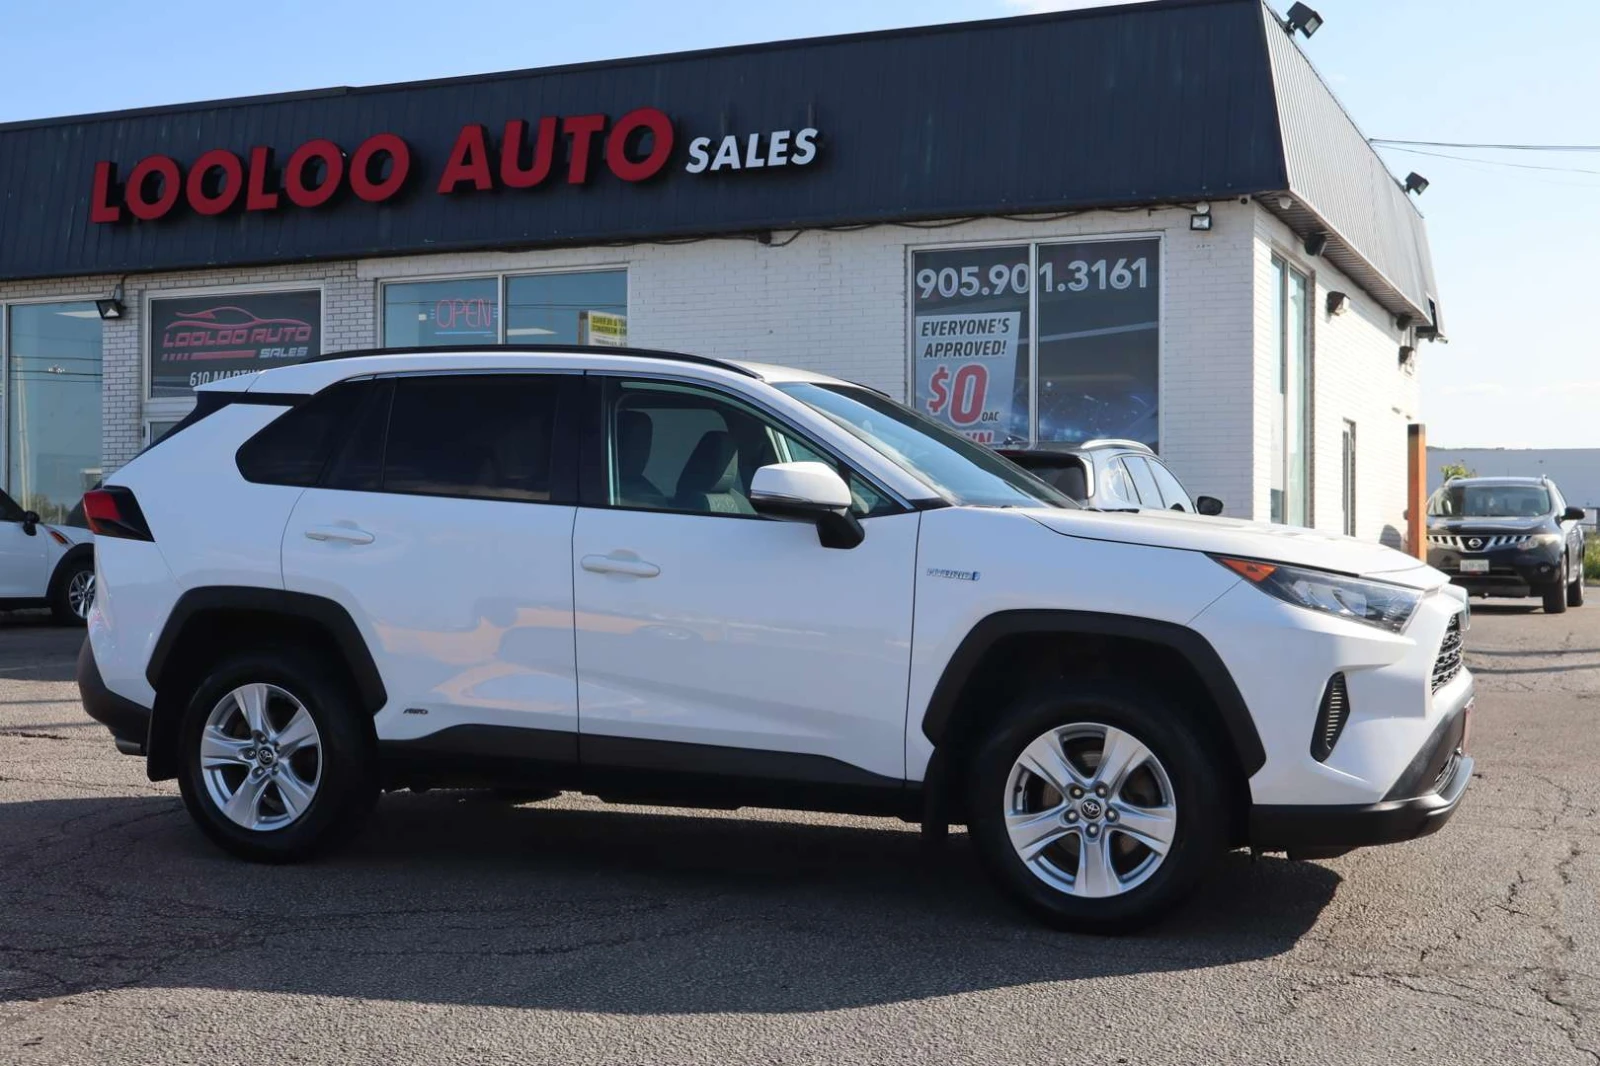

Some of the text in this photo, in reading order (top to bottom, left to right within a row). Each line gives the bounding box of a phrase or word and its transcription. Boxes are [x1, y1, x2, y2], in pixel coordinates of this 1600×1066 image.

[91, 107, 818, 223] LOOLOO AUTO SALES
[916, 257, 1147, 299] 905.901.3161
[435, 298, 491, 328] OPEN
[162, 326, 312, 348] LOOLOO AUTO
[921, 317, 1010, 337] EVERYONE'S
[259, 347, 309, 359] SALES
[924, 340, 1007, 358] APPROVED!
[189, 371, 210, 386] 610
[928, 364, 988, 424] $0
[981, 411, 999, 422] OAC
